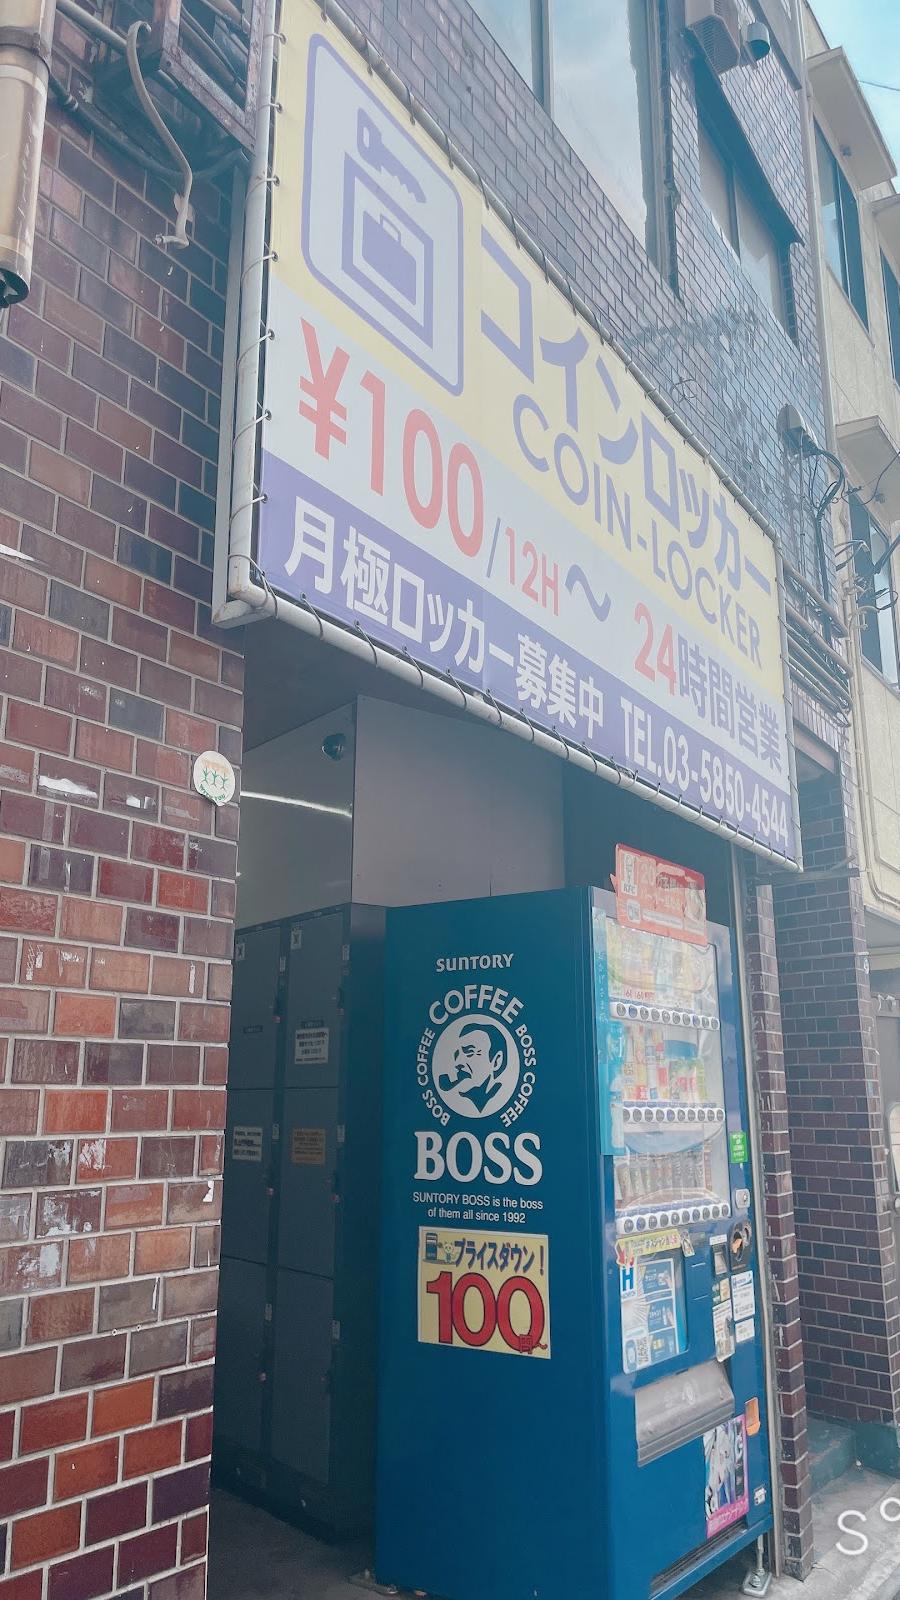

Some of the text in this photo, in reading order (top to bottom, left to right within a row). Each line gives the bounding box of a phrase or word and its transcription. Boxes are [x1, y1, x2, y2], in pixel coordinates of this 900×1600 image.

[481, 224, 771, 595] コインロッカー
[513, 394, 762, 669] COIN-LOCKER
[284, 496, 789, 847] 月極ロッカー募集中 TEL.03-5850-4544
[634, 601, 782, 773] 24時間営業
[429, 984, 525, 1025] COFFEE
[436, 953, 514, 973] SUNTORY
[416, 1027, 451, 1127] BOSS COFFEE
[500, 1023, 537, 1128] BOSS COFFEE
[412, 1191, 543, 1210] SUNTORY BOSS is the boss
[413, 1131, 543, 1186] BOSS
[427, 1207, 526, 1224] of them all since 1992
